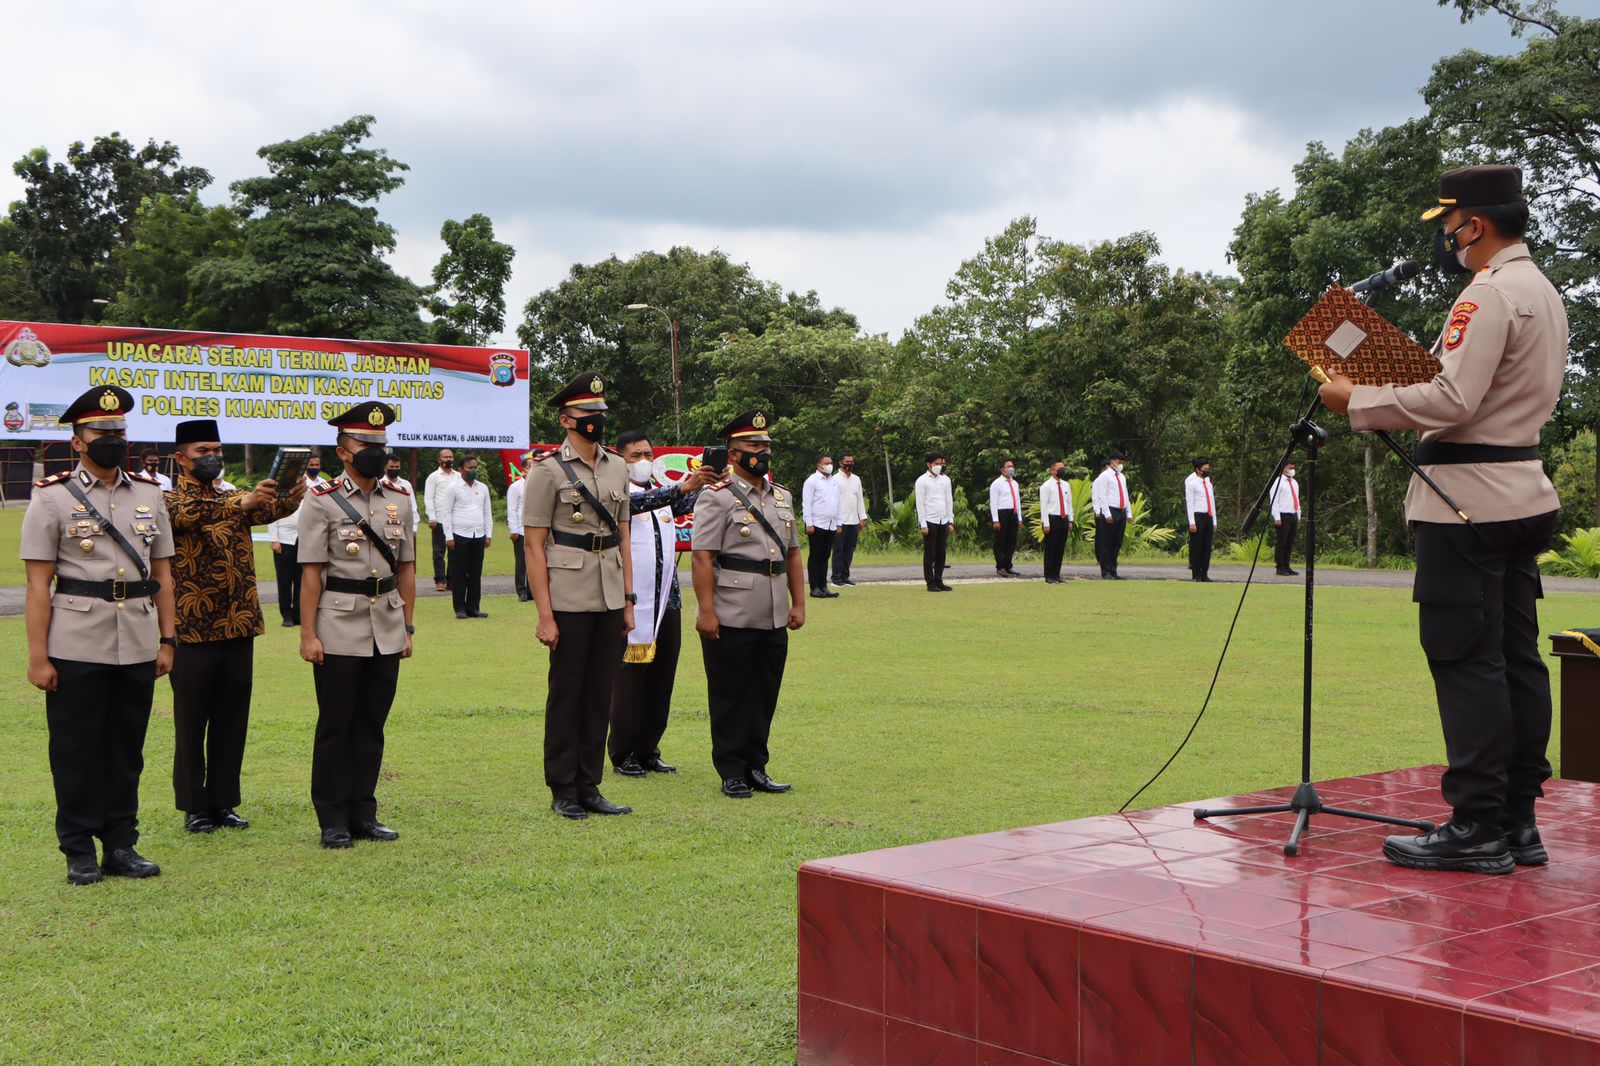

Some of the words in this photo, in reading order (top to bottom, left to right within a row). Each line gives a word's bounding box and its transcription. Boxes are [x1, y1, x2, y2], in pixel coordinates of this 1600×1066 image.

[106, 341, 203, 364] UPACARA
[208, 347, 273, 368] SERAH
[278, 351, 348, 371] TERIMA
[352, 353, 431, 375] JABATAN
[89, 367, 159, 388] KASAT
[164, 370, 265, 393] INTELKAM
[270, 374, 309, 394] DAN
[314, 377, 373, 397] KASAT
[377, 379, 444, 400] LANTAS
[142, 395, 220, 416] POLRES
[225, 398, 316, 419] KUANTAN
[397, 432, 421, 441] TELUK
[422, 433, 460, 443] KUANTAN,
[466, 434, 497, 443] JANUARI
[498, 435, 515, 443] 2022
